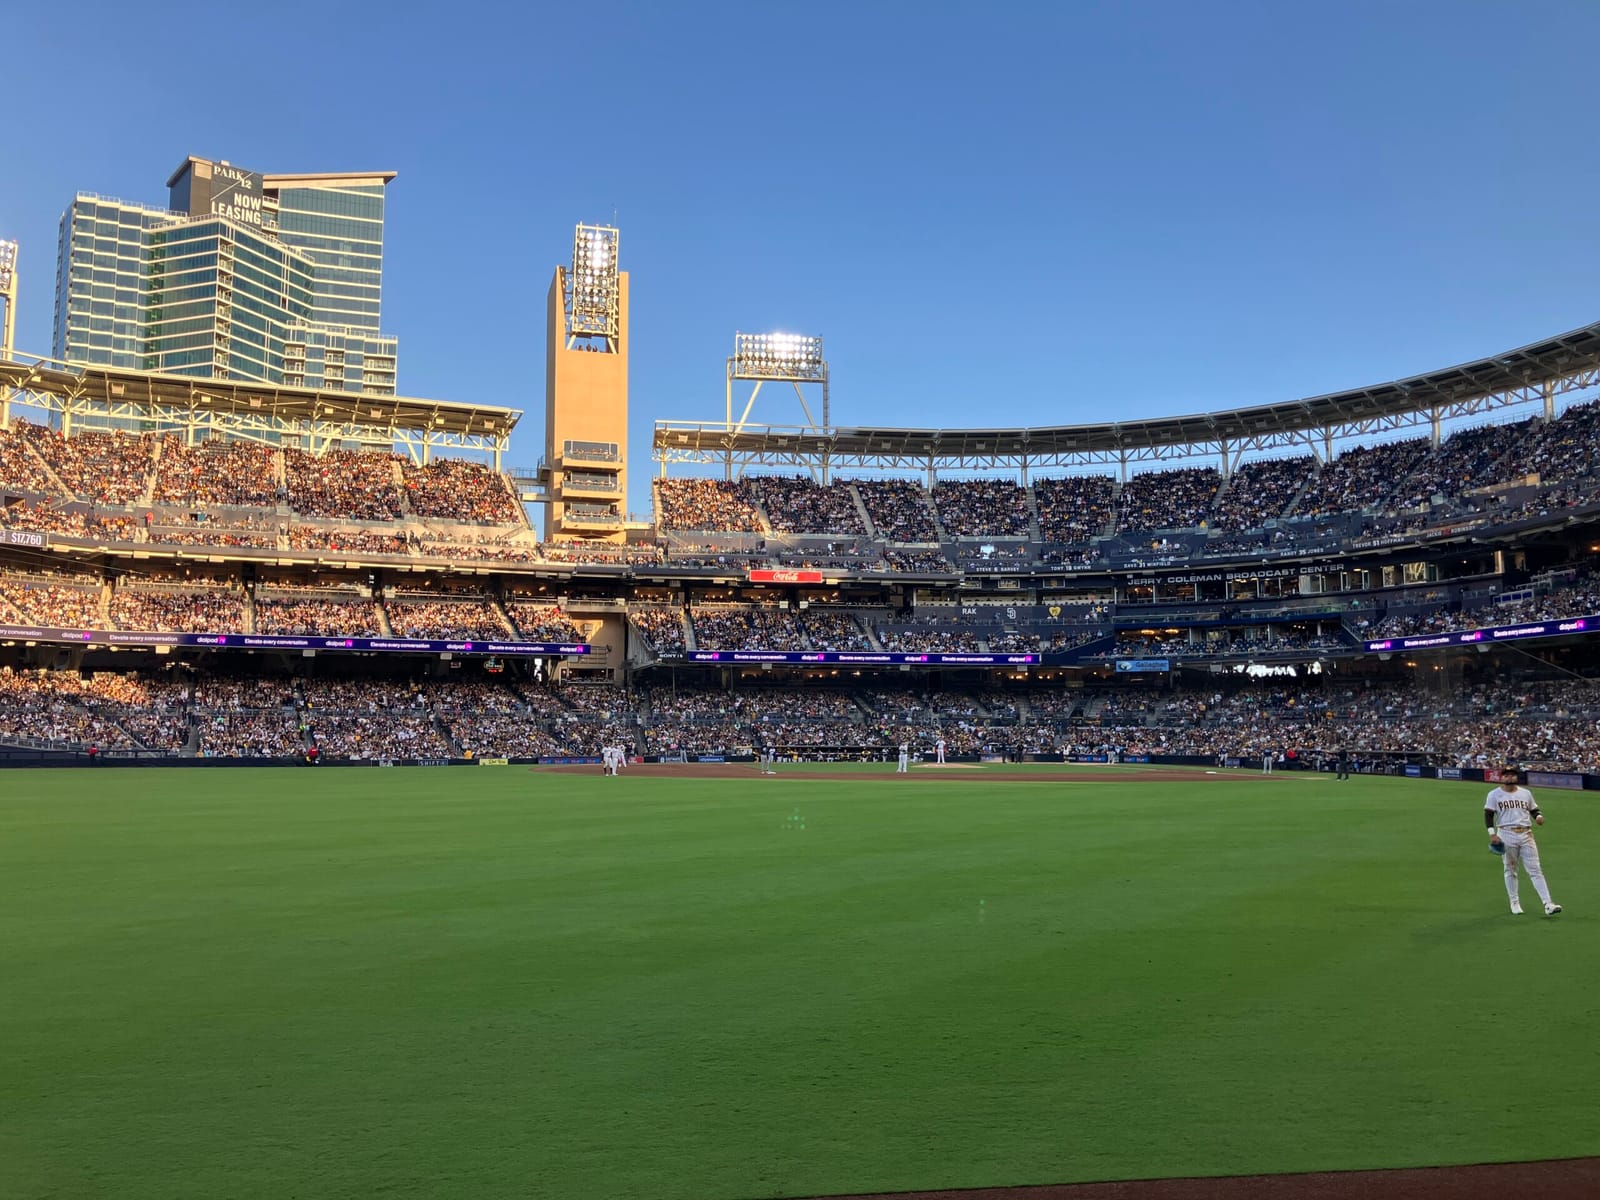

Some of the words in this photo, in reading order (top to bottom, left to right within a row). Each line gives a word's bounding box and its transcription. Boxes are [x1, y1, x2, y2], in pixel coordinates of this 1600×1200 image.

[213, 165, 244, 180] PARK
[240, 179, 252, 189] 12
[234, 193, 261, 210] NOW
[211, 201, 261, 225] LEASING
[11, 532, 42, 545] $17,760
[772, 571, 798, 580] Coca-Cola
[1167, 574, 1222, 583] COLEMAN
[1226, 568, 1295, 580] BROADCAST
[1300, 563, 1344, 574] CENTER
[62, 632, 83, 640] dialpad
[1498, 800, 1529, 810] PADRES
